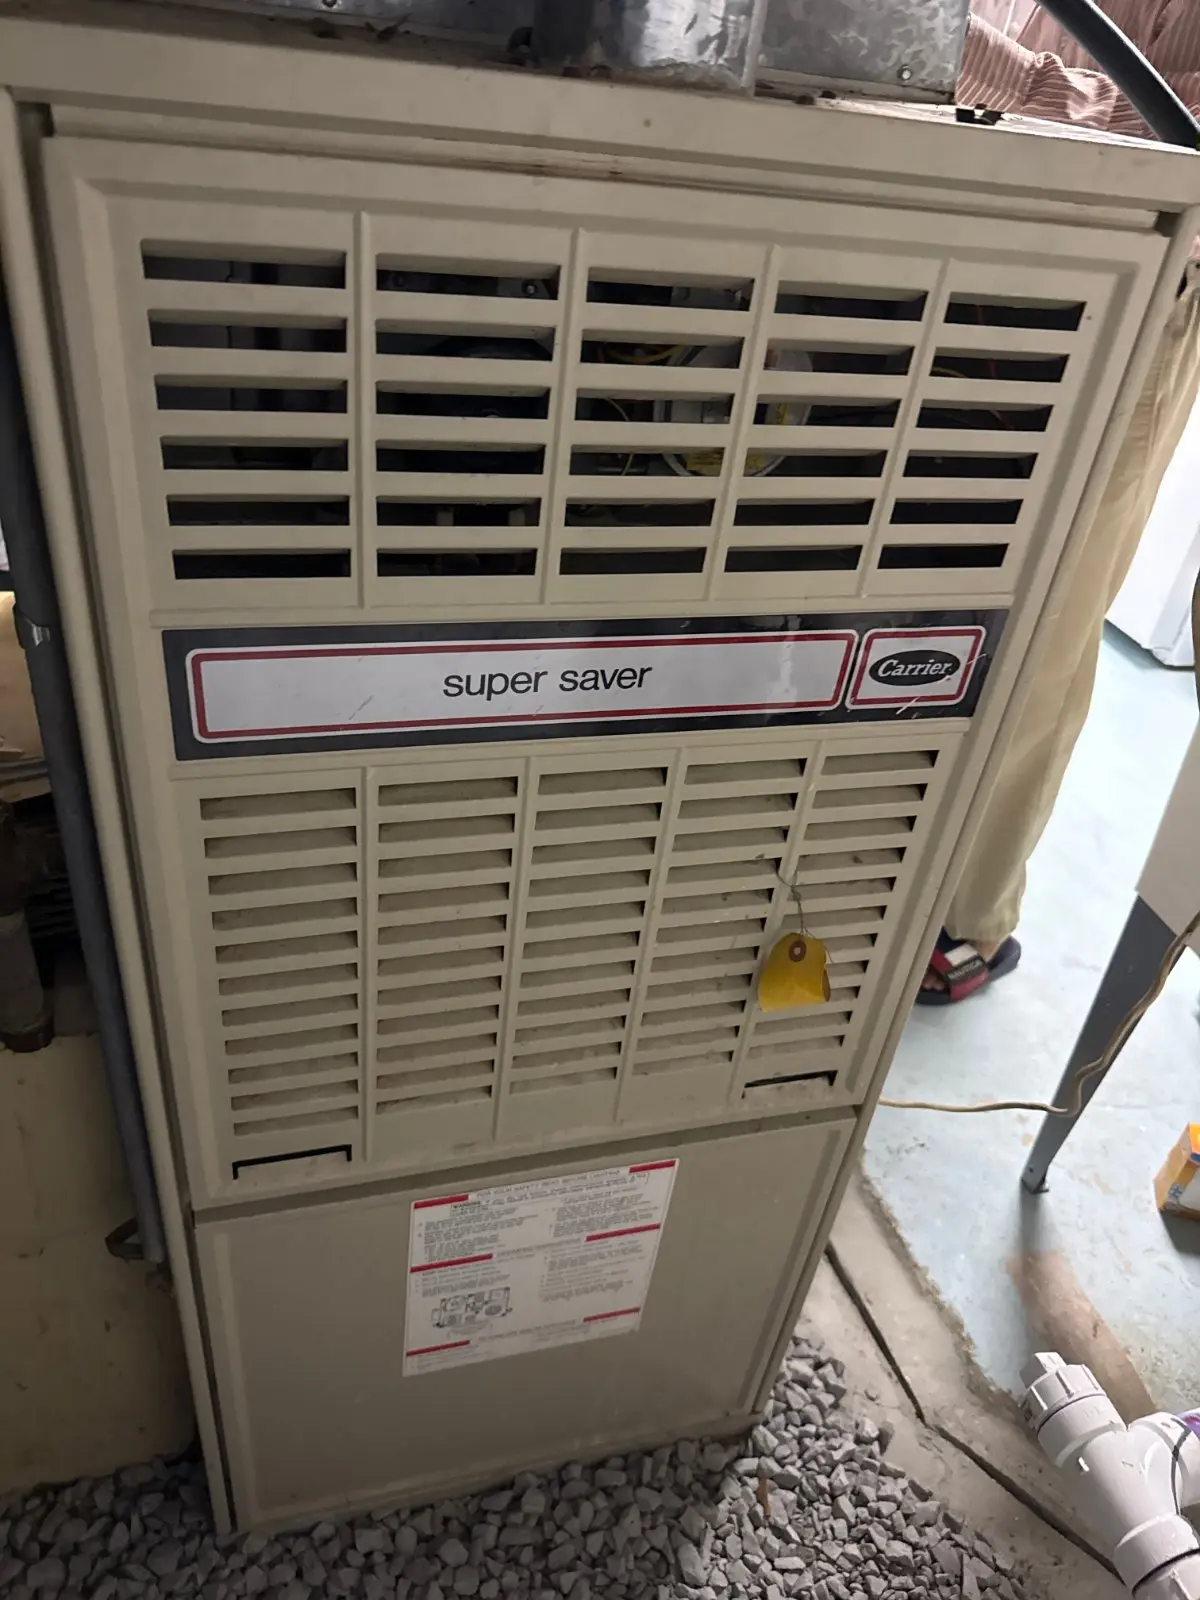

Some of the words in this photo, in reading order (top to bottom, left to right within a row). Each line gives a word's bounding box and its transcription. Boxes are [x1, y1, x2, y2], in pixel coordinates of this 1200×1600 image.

[877, 658, 953, 677] Carrier
[443, 671, 548, 701] super
[558, 666, 653, 692] saver
